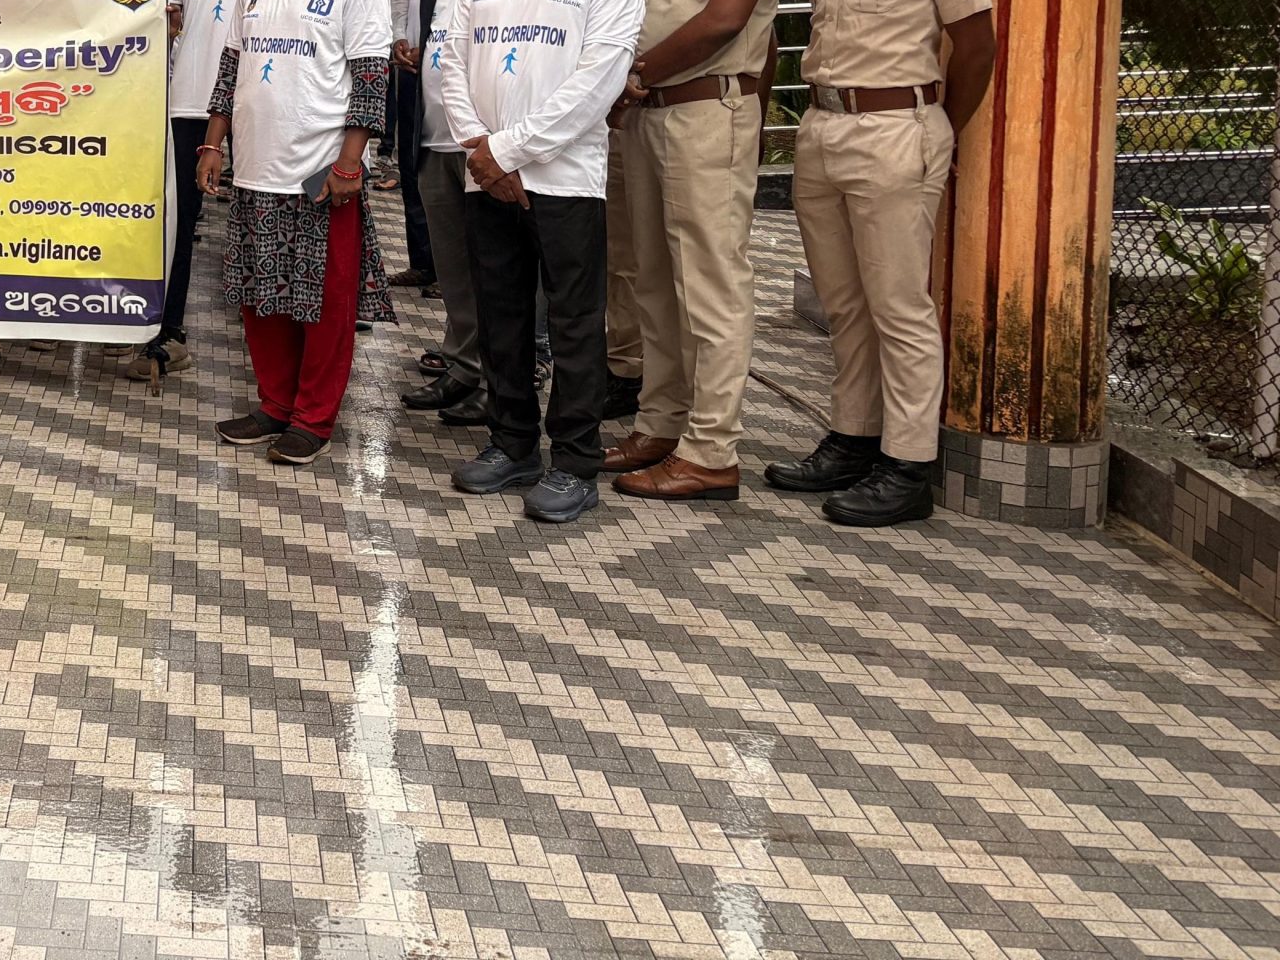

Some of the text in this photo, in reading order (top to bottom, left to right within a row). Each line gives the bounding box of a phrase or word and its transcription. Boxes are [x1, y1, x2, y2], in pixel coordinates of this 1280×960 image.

[250, 36, 260, 53] TO
[260, 37, 318, 58] CORRUPTION
[474, 25, 567, 47] NO TO CORRUPTION
[4, 290, 148, 317] ଅନୁଗୋଳ
